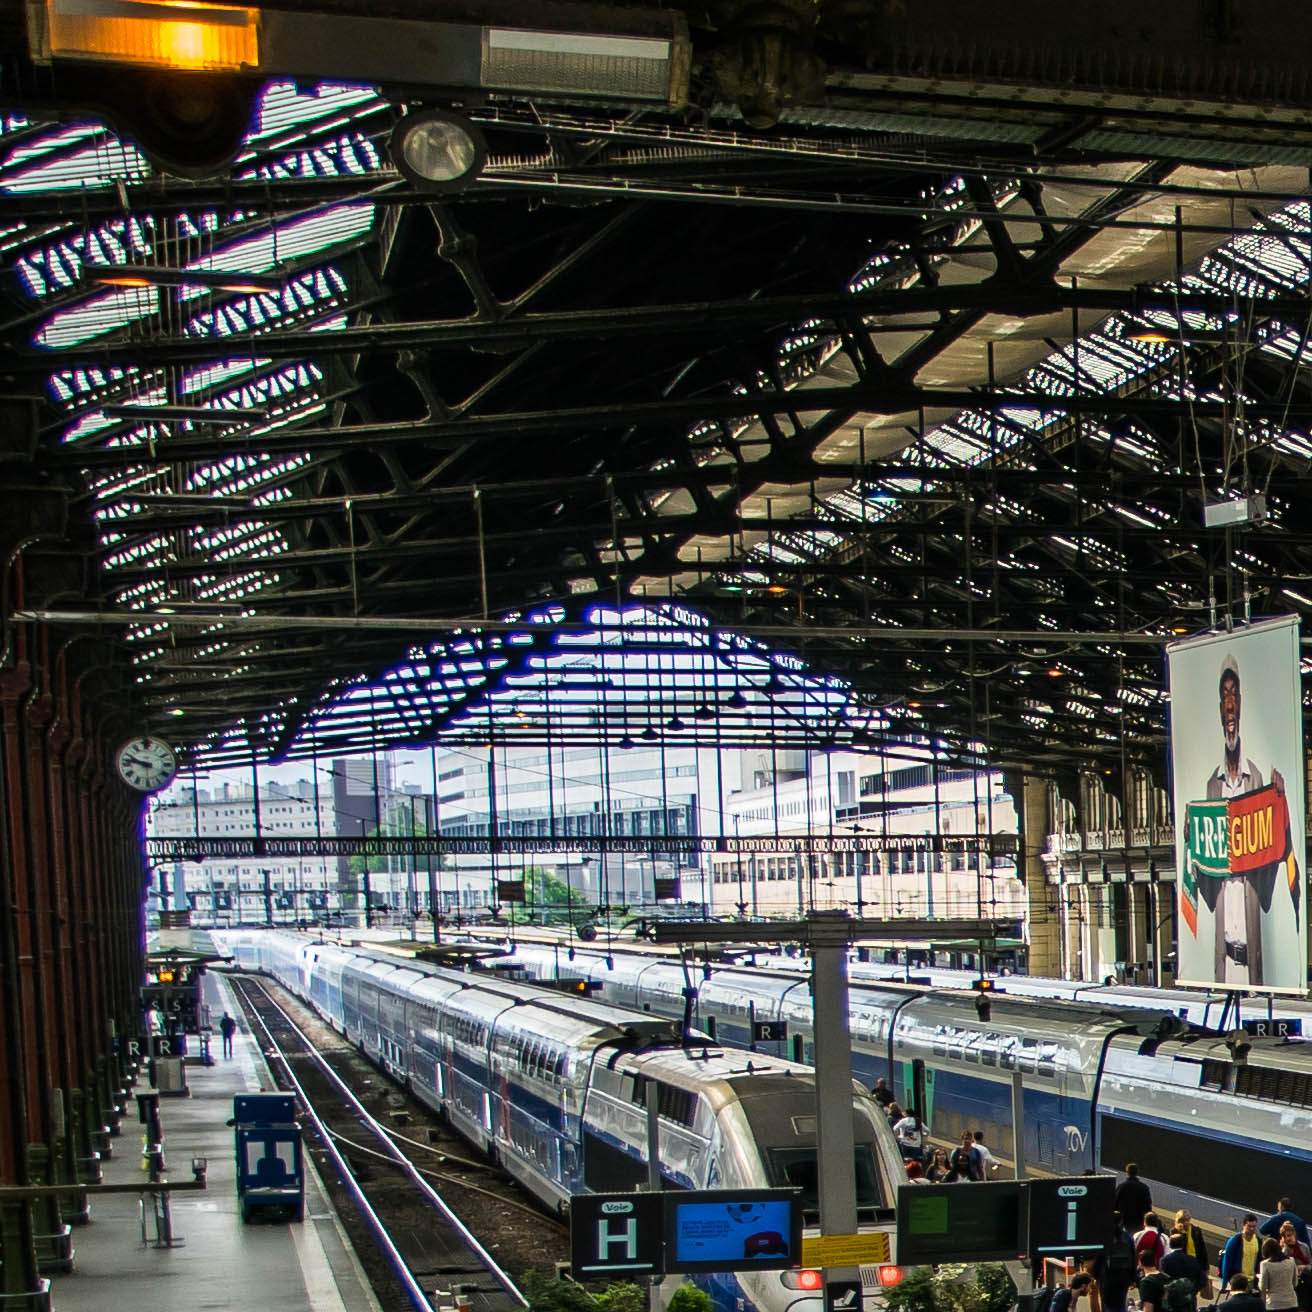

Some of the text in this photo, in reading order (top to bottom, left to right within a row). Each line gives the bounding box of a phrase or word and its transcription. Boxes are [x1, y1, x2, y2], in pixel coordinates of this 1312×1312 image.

[1231, 806, 1274, 859] GIUM
[761, 1025, 771, 1040] R
[1257, 1023, 1288, 1036] R R
[128, 1040, 171, 1055] R R
[1062, 1187, 1083, 1195] Voie
[598, 1218, 637, 1260] H
